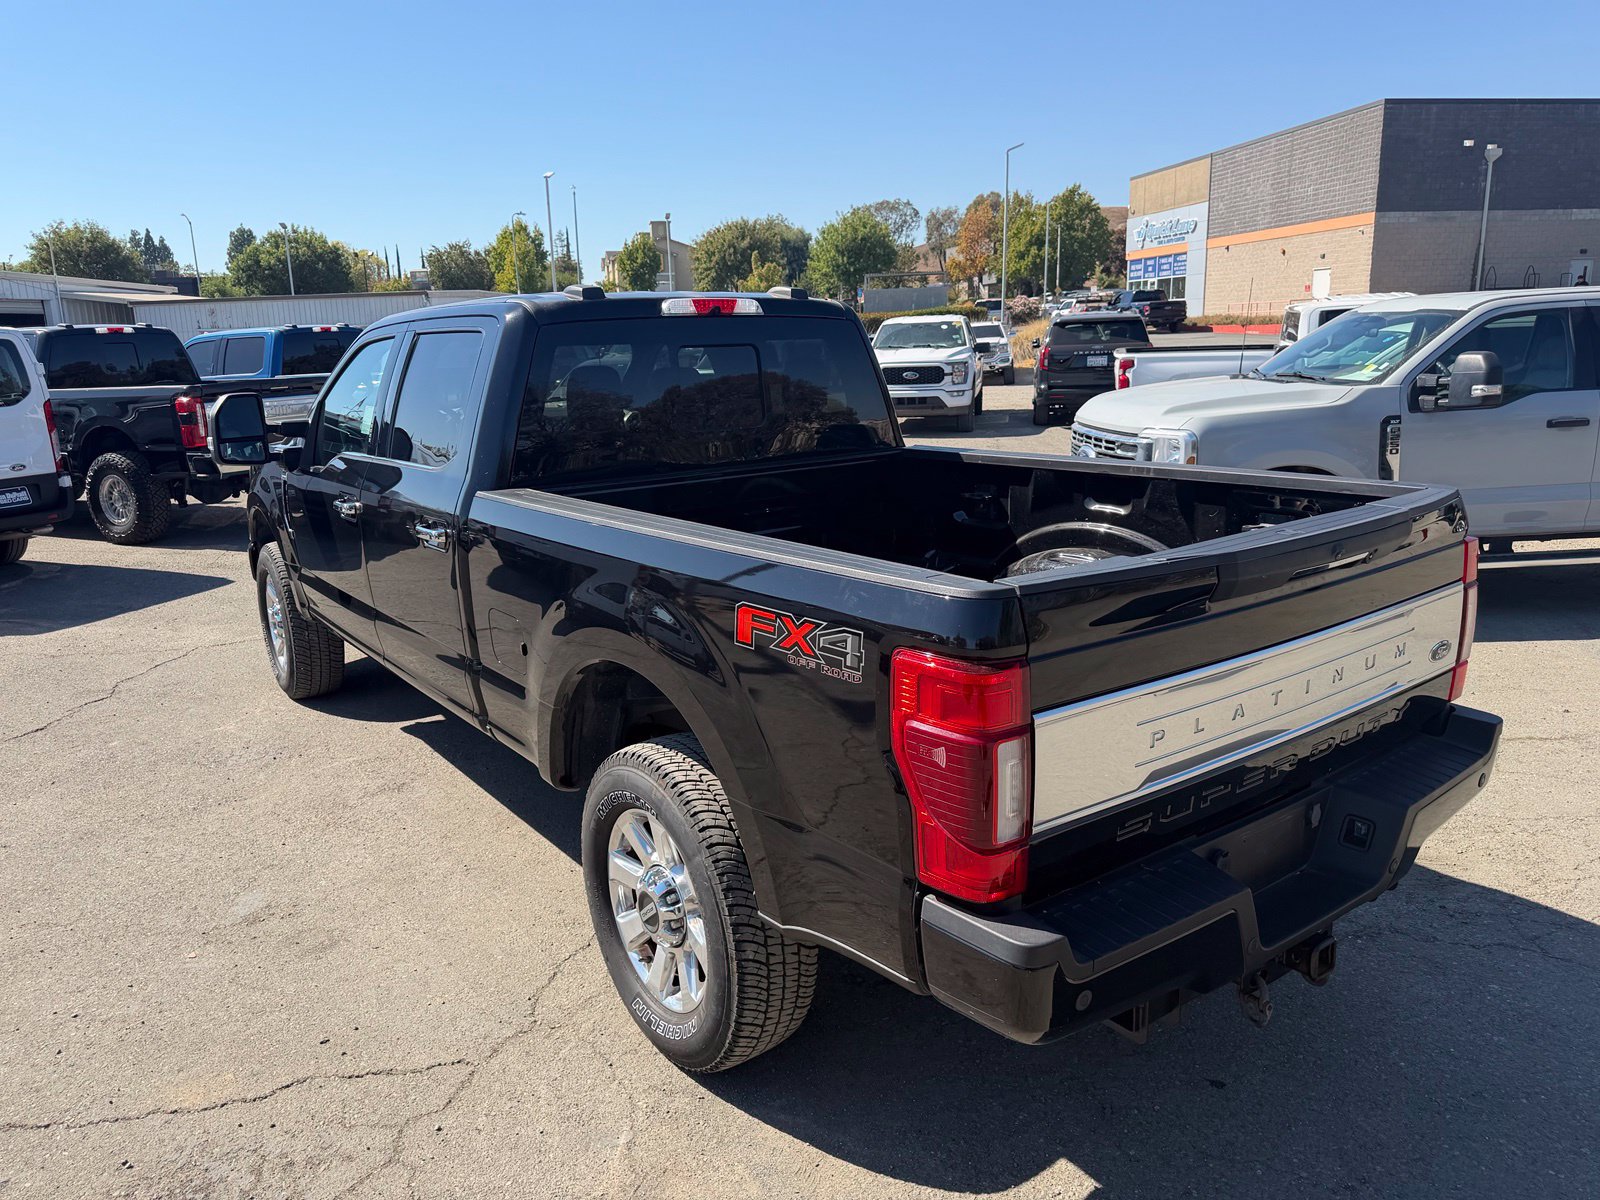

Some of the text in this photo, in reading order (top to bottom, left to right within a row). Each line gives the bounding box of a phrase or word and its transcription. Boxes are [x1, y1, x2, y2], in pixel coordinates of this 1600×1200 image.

[734, 601, 864, 674] FX4
[787, 654, 862, 683] OFF ROAD
[1149, 642, 1407, 749] PLATINUM
[1116, 700, 1411, 842] SUPER DUTY
[631, 997, 698, 1040] MICHELIN
